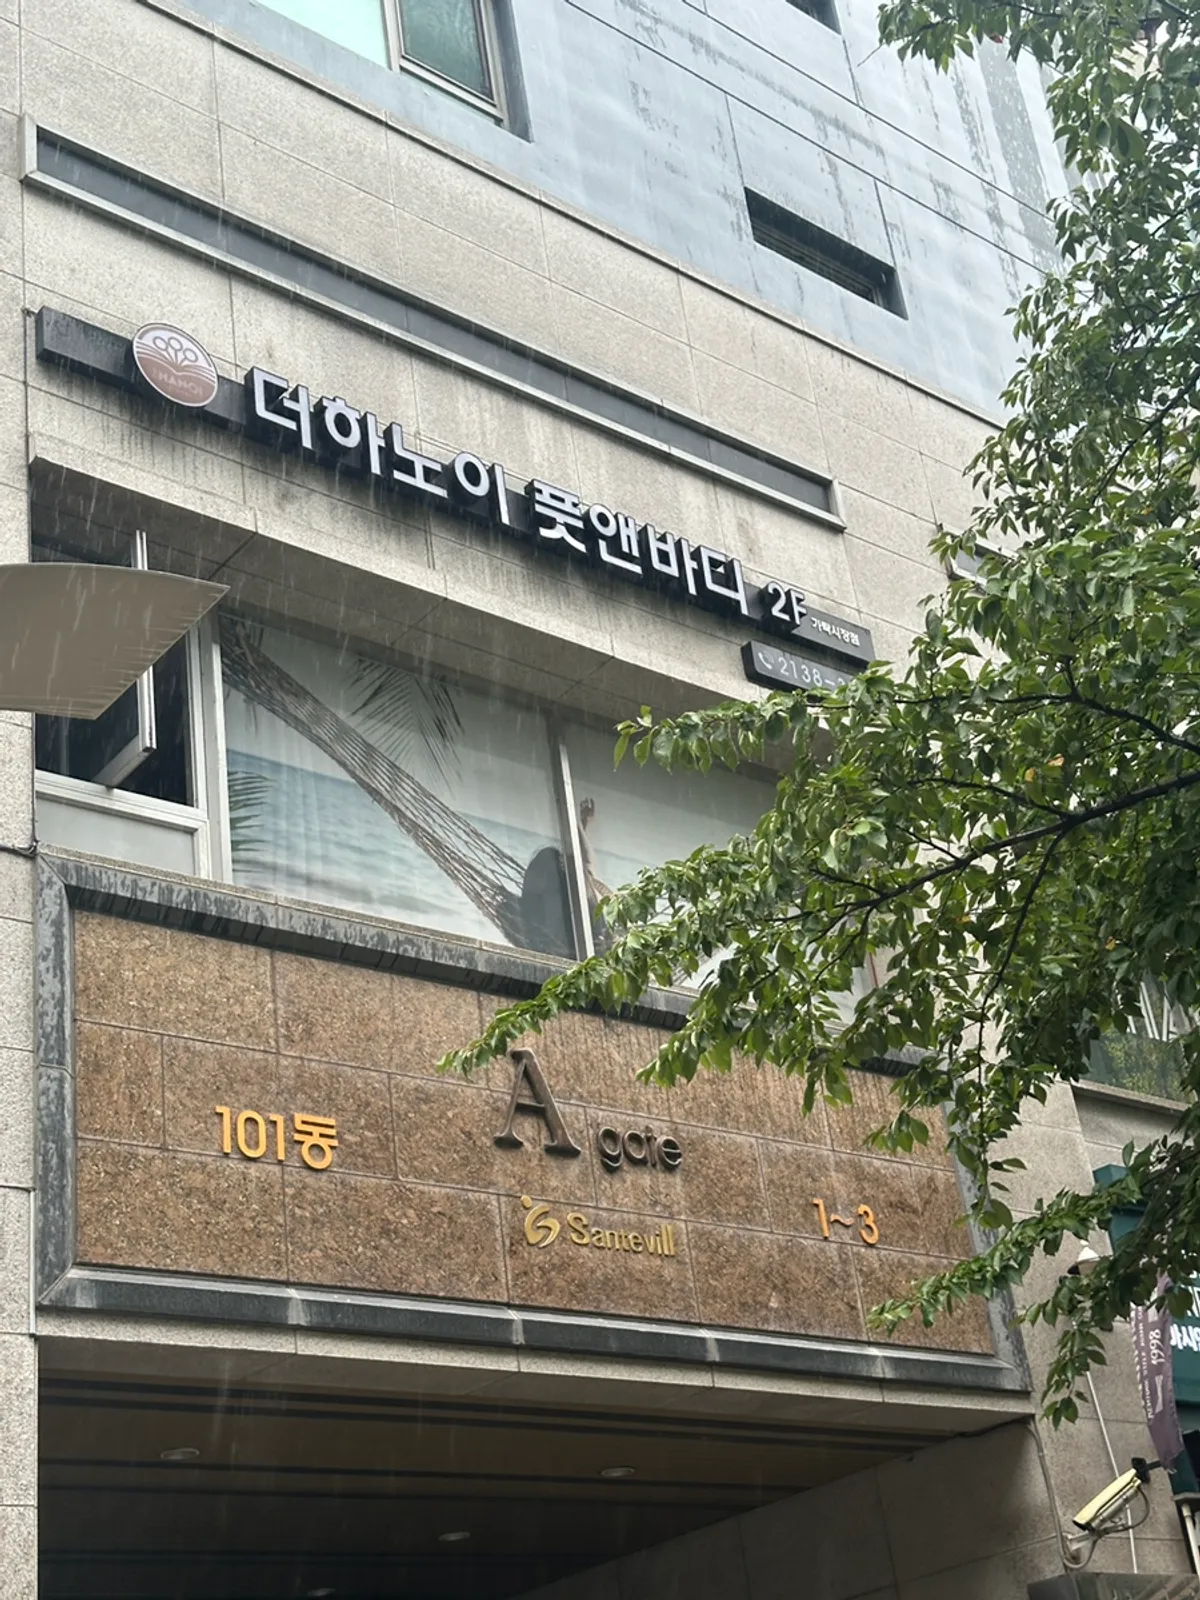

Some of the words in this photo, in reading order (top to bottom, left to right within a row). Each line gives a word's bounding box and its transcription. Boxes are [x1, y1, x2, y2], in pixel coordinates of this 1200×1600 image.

[250, 366, 510, 526] 더하노이
[533, 479, 749, 616] 풋앤바디
[767, 581, 807, 626] 2F
[215, 1105, 339, 1170] 101동
[492, 1048, 582, 1157] A
[598, 1126, 683, 1172] gate
[566, 1211, 677, 1257] Santevill
[1148, 1328, 1166, 1366] 1998
